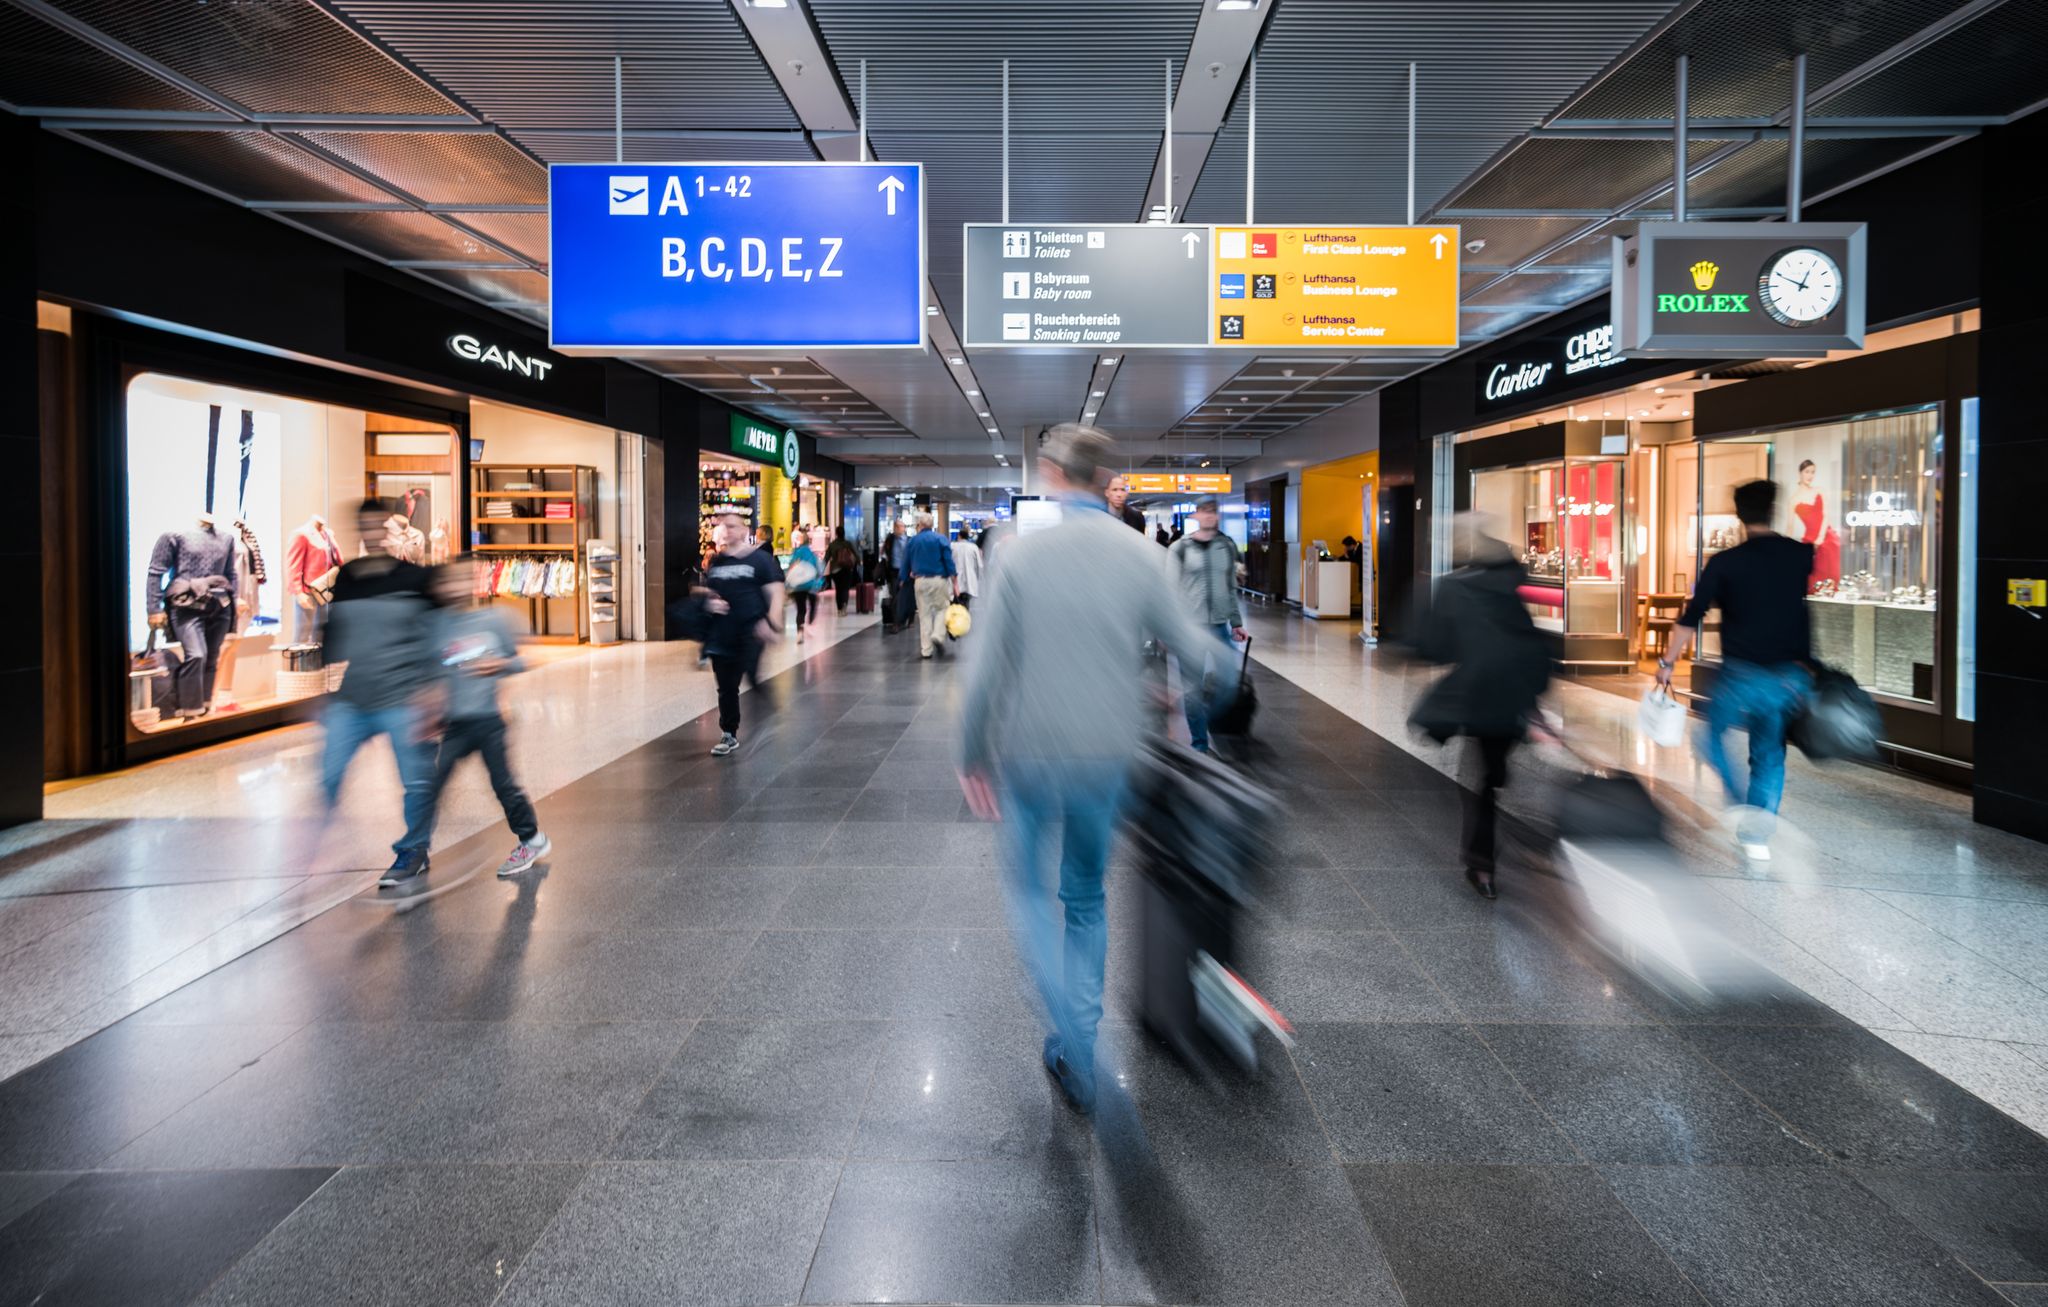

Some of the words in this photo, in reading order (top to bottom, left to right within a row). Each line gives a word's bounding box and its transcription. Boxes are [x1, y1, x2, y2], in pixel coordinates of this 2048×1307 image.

[658, 175, 689, 216] A
[1033, 231, 1084, 244] Toiletten
[1303, 233, 1356, 243] Lufthansa
[1034, 246, 1071, 259] Toilets
[1303, 244, 1328, 255] First
[1330, 244, 1362, 255] Class
[1364, 244, 1406, 257] Lounge
[1034, 272, 1090, 286] Babyraum
[1303, 274, 1356, 284] Lufthansa
[1033, 288, 1062, 302] Baby
[1063, 289, 1092, 300] room
[1302, 285, 1354, 296] Business
[1355, 285, 1398, 298] Lounge
[1657, 294, 1751, 313] ROLEX
[1034, 313, 1121, 326] Raucherbereich
[1303, 315, 1356, 325] Lufthansa
[1033, 328, 1081, 343] Smoking
[1082, 328, 1121, 343] lounge
[1302, 326, 1345, 336] Service
[1346, 326, 1386, 336] Center
[451, 334, 553, 381] GANT
[1486, 362, 1552, 400] Cartier
